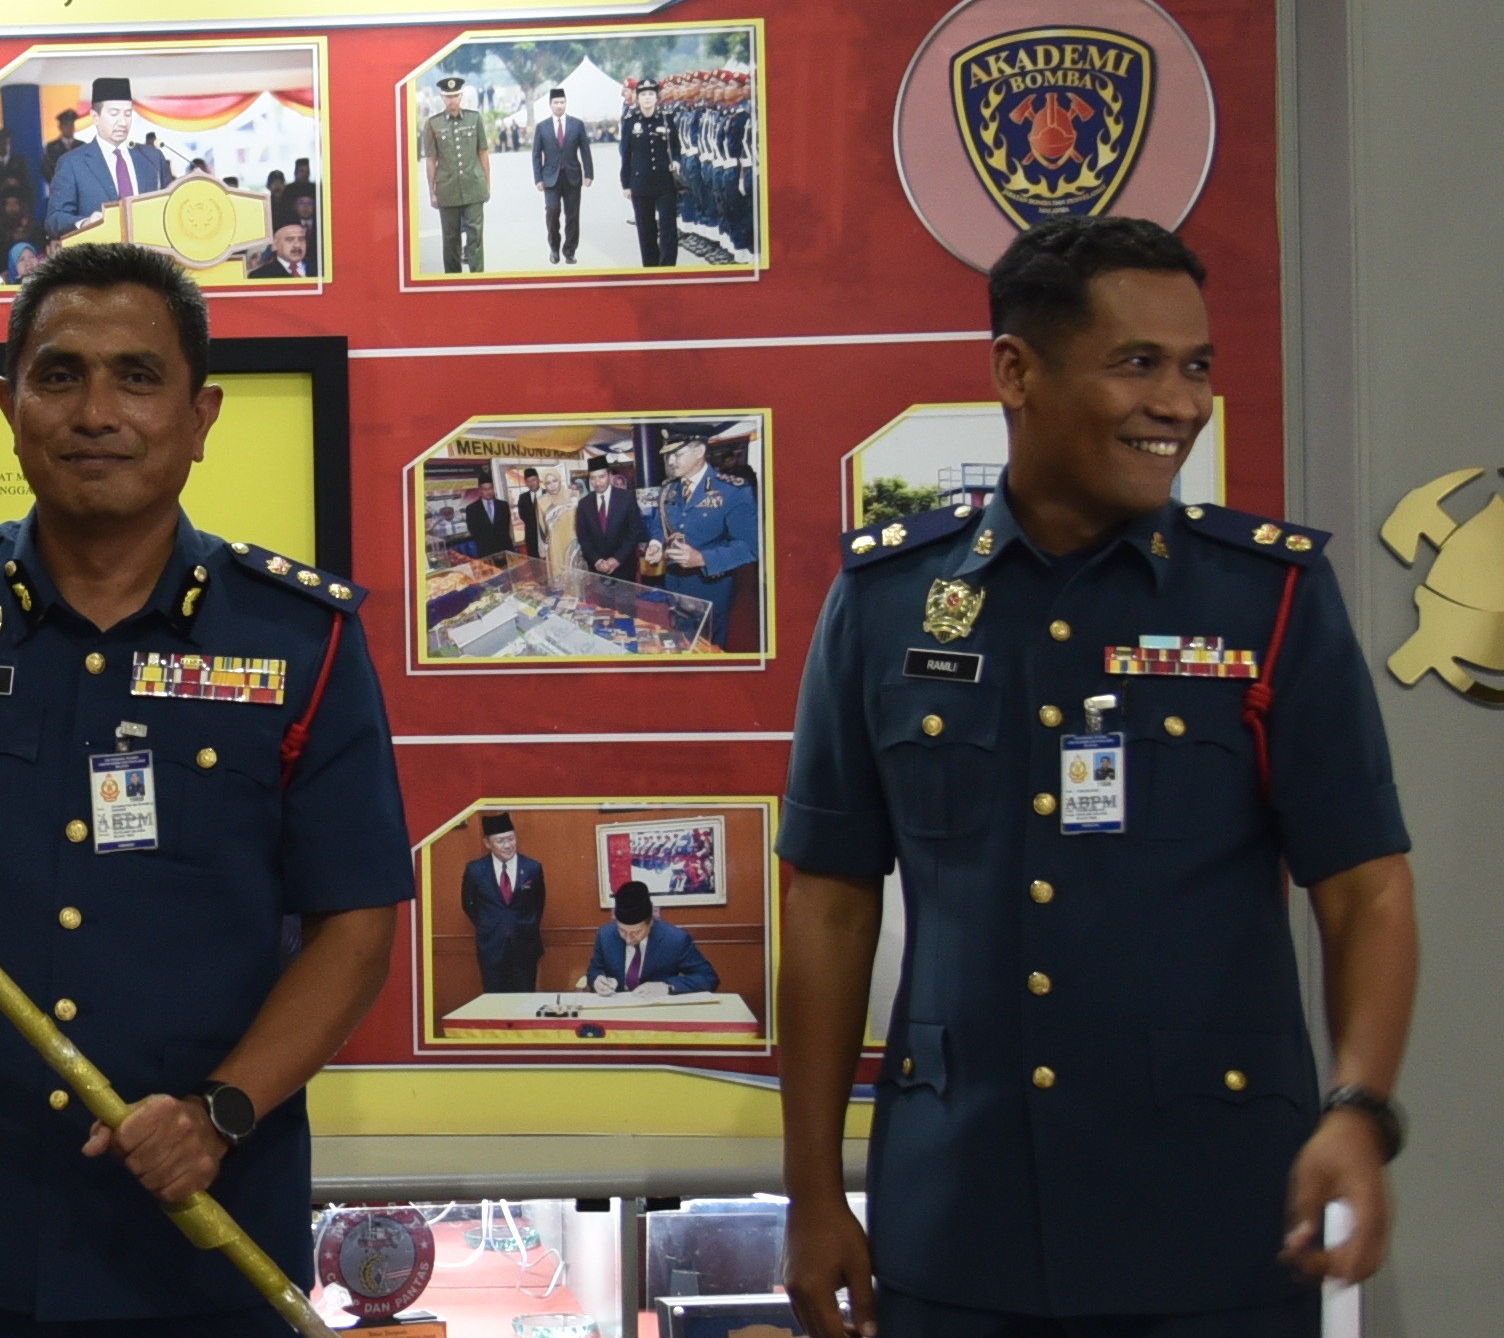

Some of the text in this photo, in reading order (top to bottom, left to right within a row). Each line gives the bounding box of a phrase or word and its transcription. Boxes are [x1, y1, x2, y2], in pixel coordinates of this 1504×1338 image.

[968, 42, 1135, 90] AKADEMI
[1009, 69, 1096, 93] BOMBA
[926, 658, 960, 674] RAMLI
[363, 1301, 391, 1314] DAN
[395, 1261, 430, 1309] PANTAS
